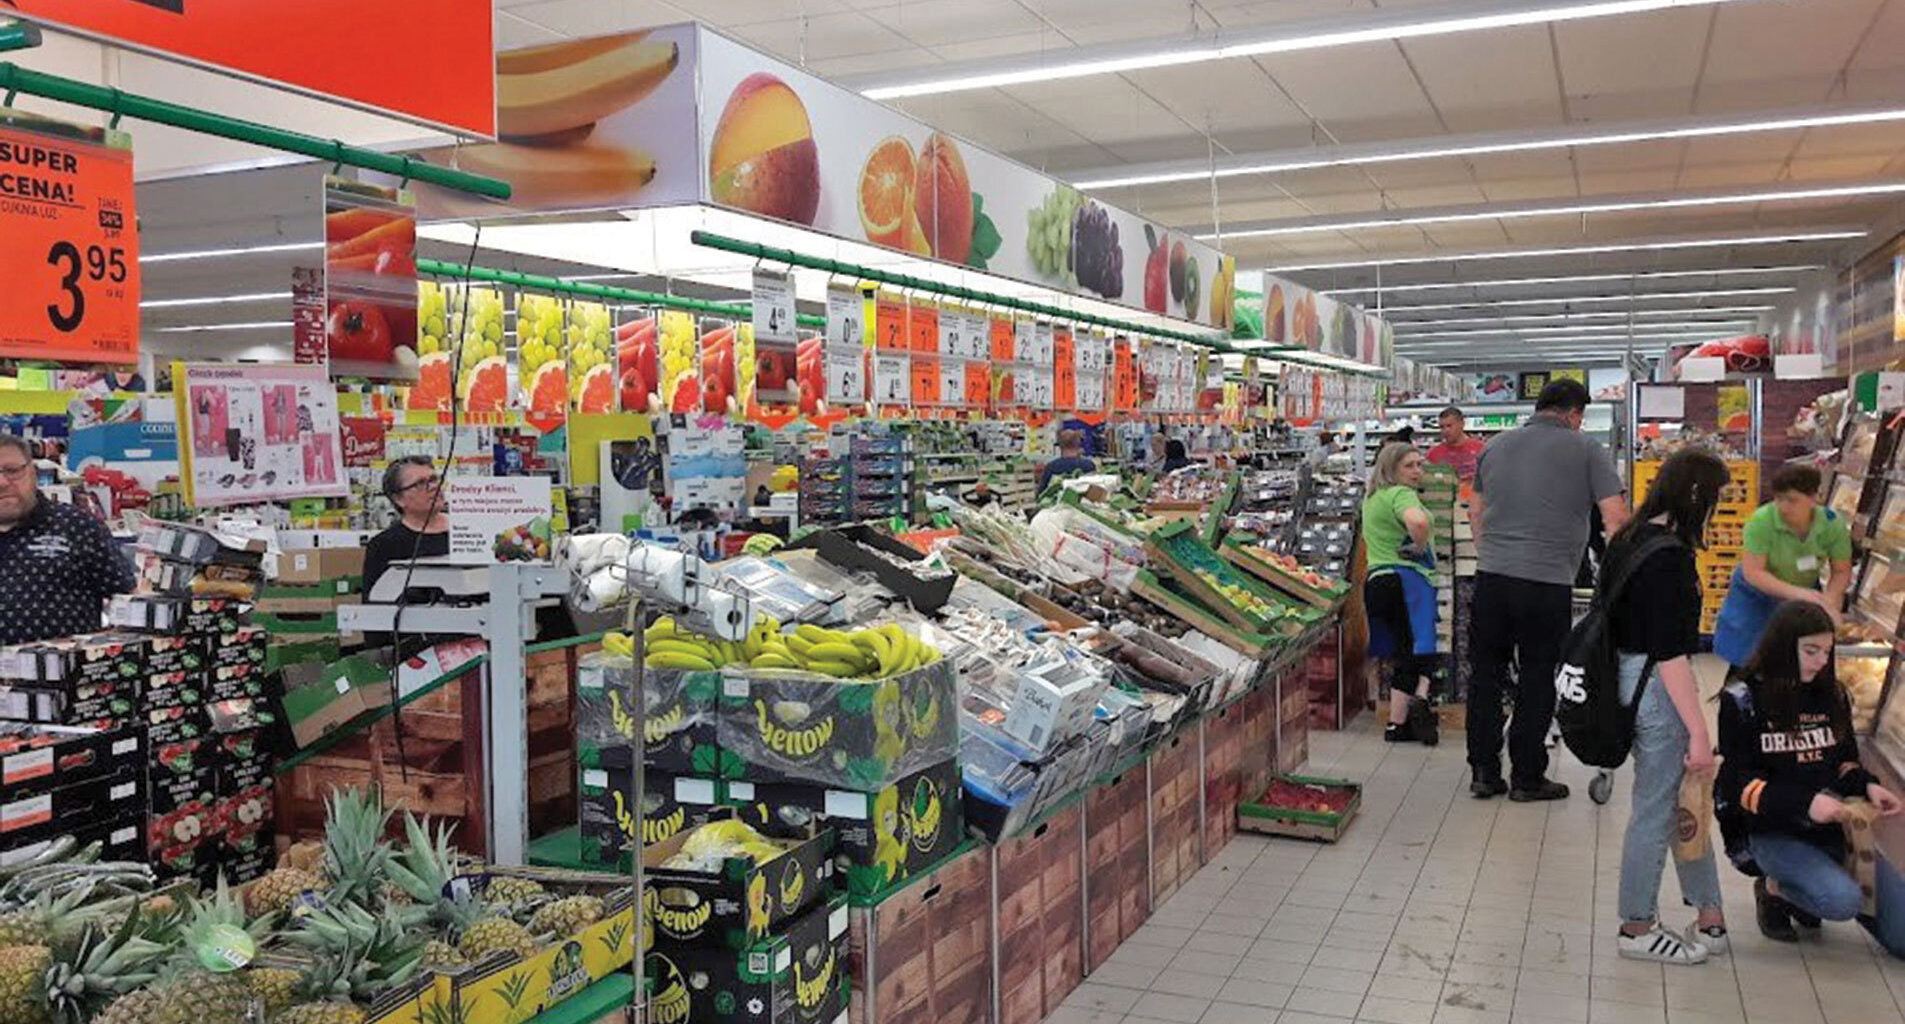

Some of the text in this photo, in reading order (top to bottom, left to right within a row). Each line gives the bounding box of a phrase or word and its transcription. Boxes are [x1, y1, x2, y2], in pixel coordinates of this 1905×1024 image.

[0, 143, 78, 174] SUPER
[1, 174, 75, 203] CENA!
[47, 241, 127, 332] 3 95
